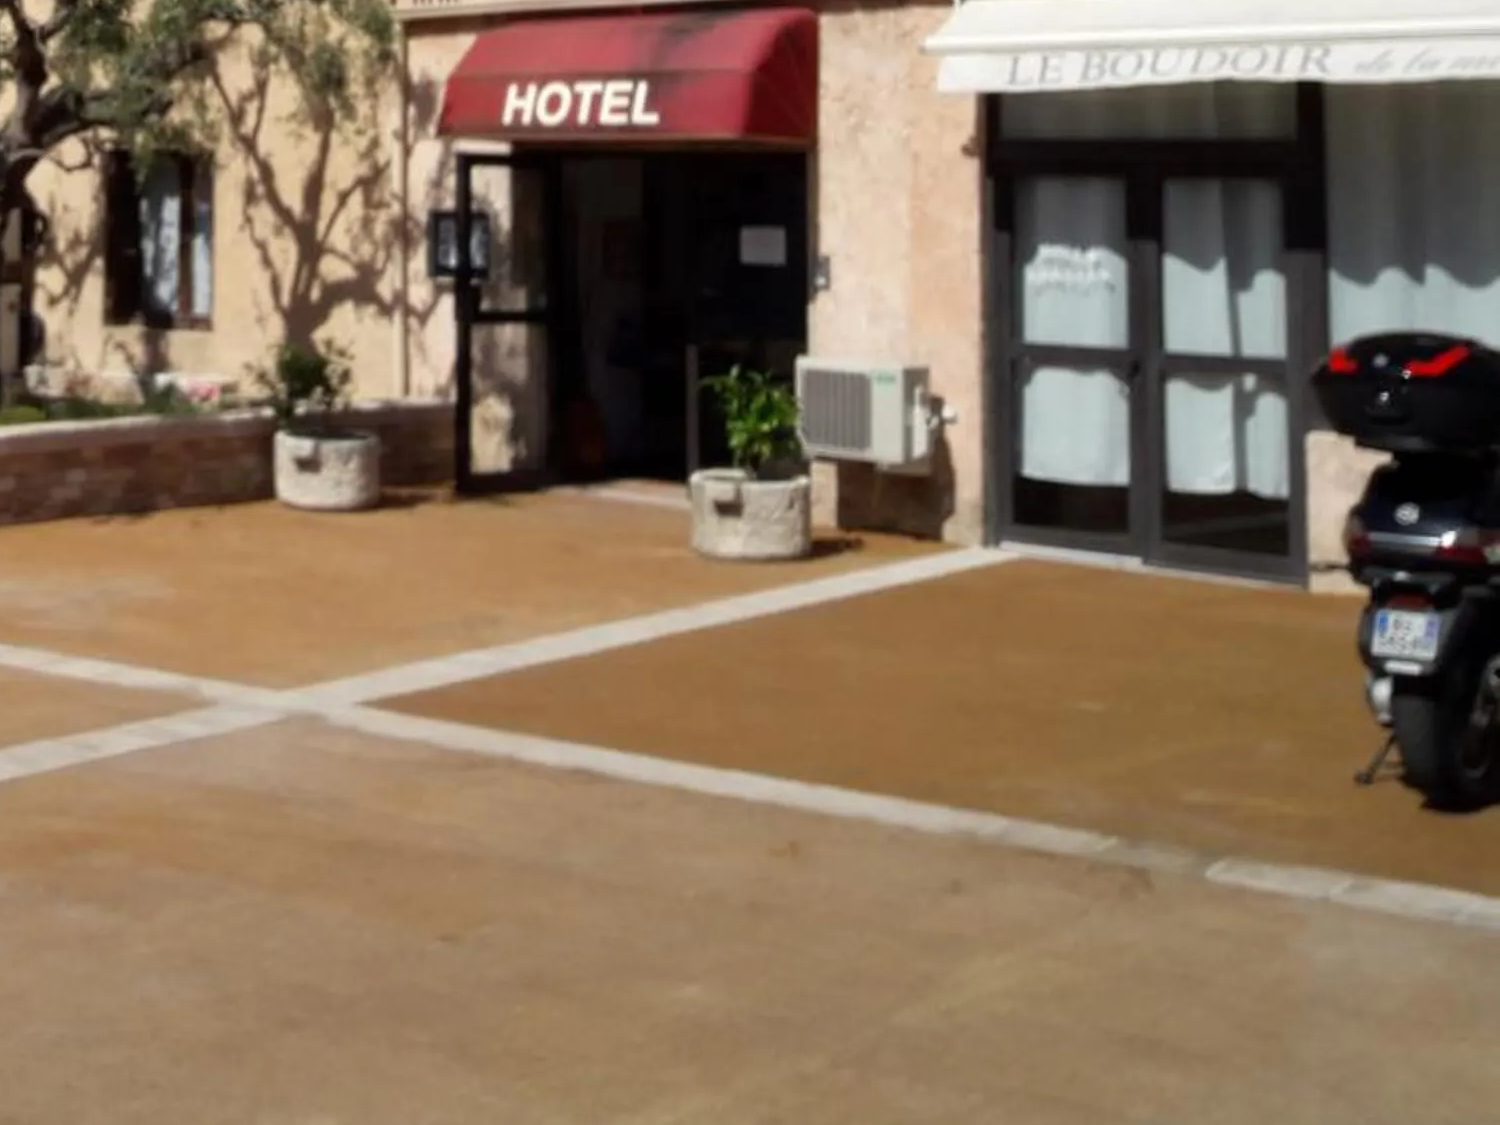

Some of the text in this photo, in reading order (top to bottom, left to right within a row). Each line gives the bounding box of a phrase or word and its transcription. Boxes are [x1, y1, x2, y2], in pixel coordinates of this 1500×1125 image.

[1007, 54, 1064, 86] LE
[1078, 42, 1332, 83] BOUDOIR
[502, 80, 660, 127] HOTEL
